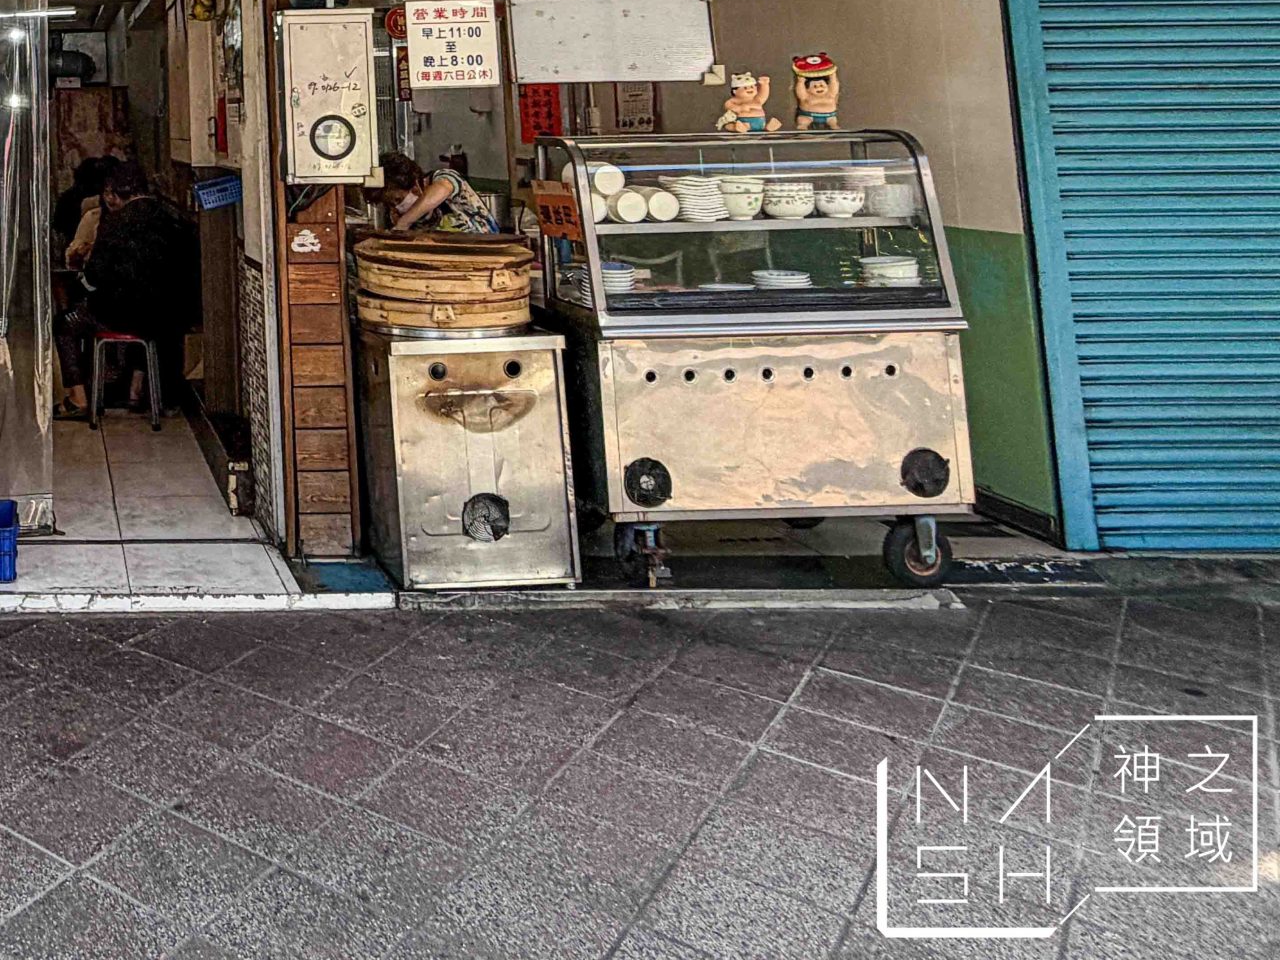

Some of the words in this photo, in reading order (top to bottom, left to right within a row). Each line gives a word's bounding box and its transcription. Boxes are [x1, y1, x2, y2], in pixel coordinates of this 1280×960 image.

[412, 6, 488, 21] 營業時間
[421, 26, 482, 39] 早上11:00
[445, 41, 458, 53] 至
[423, 54, 484, 68] 晚上8:00
